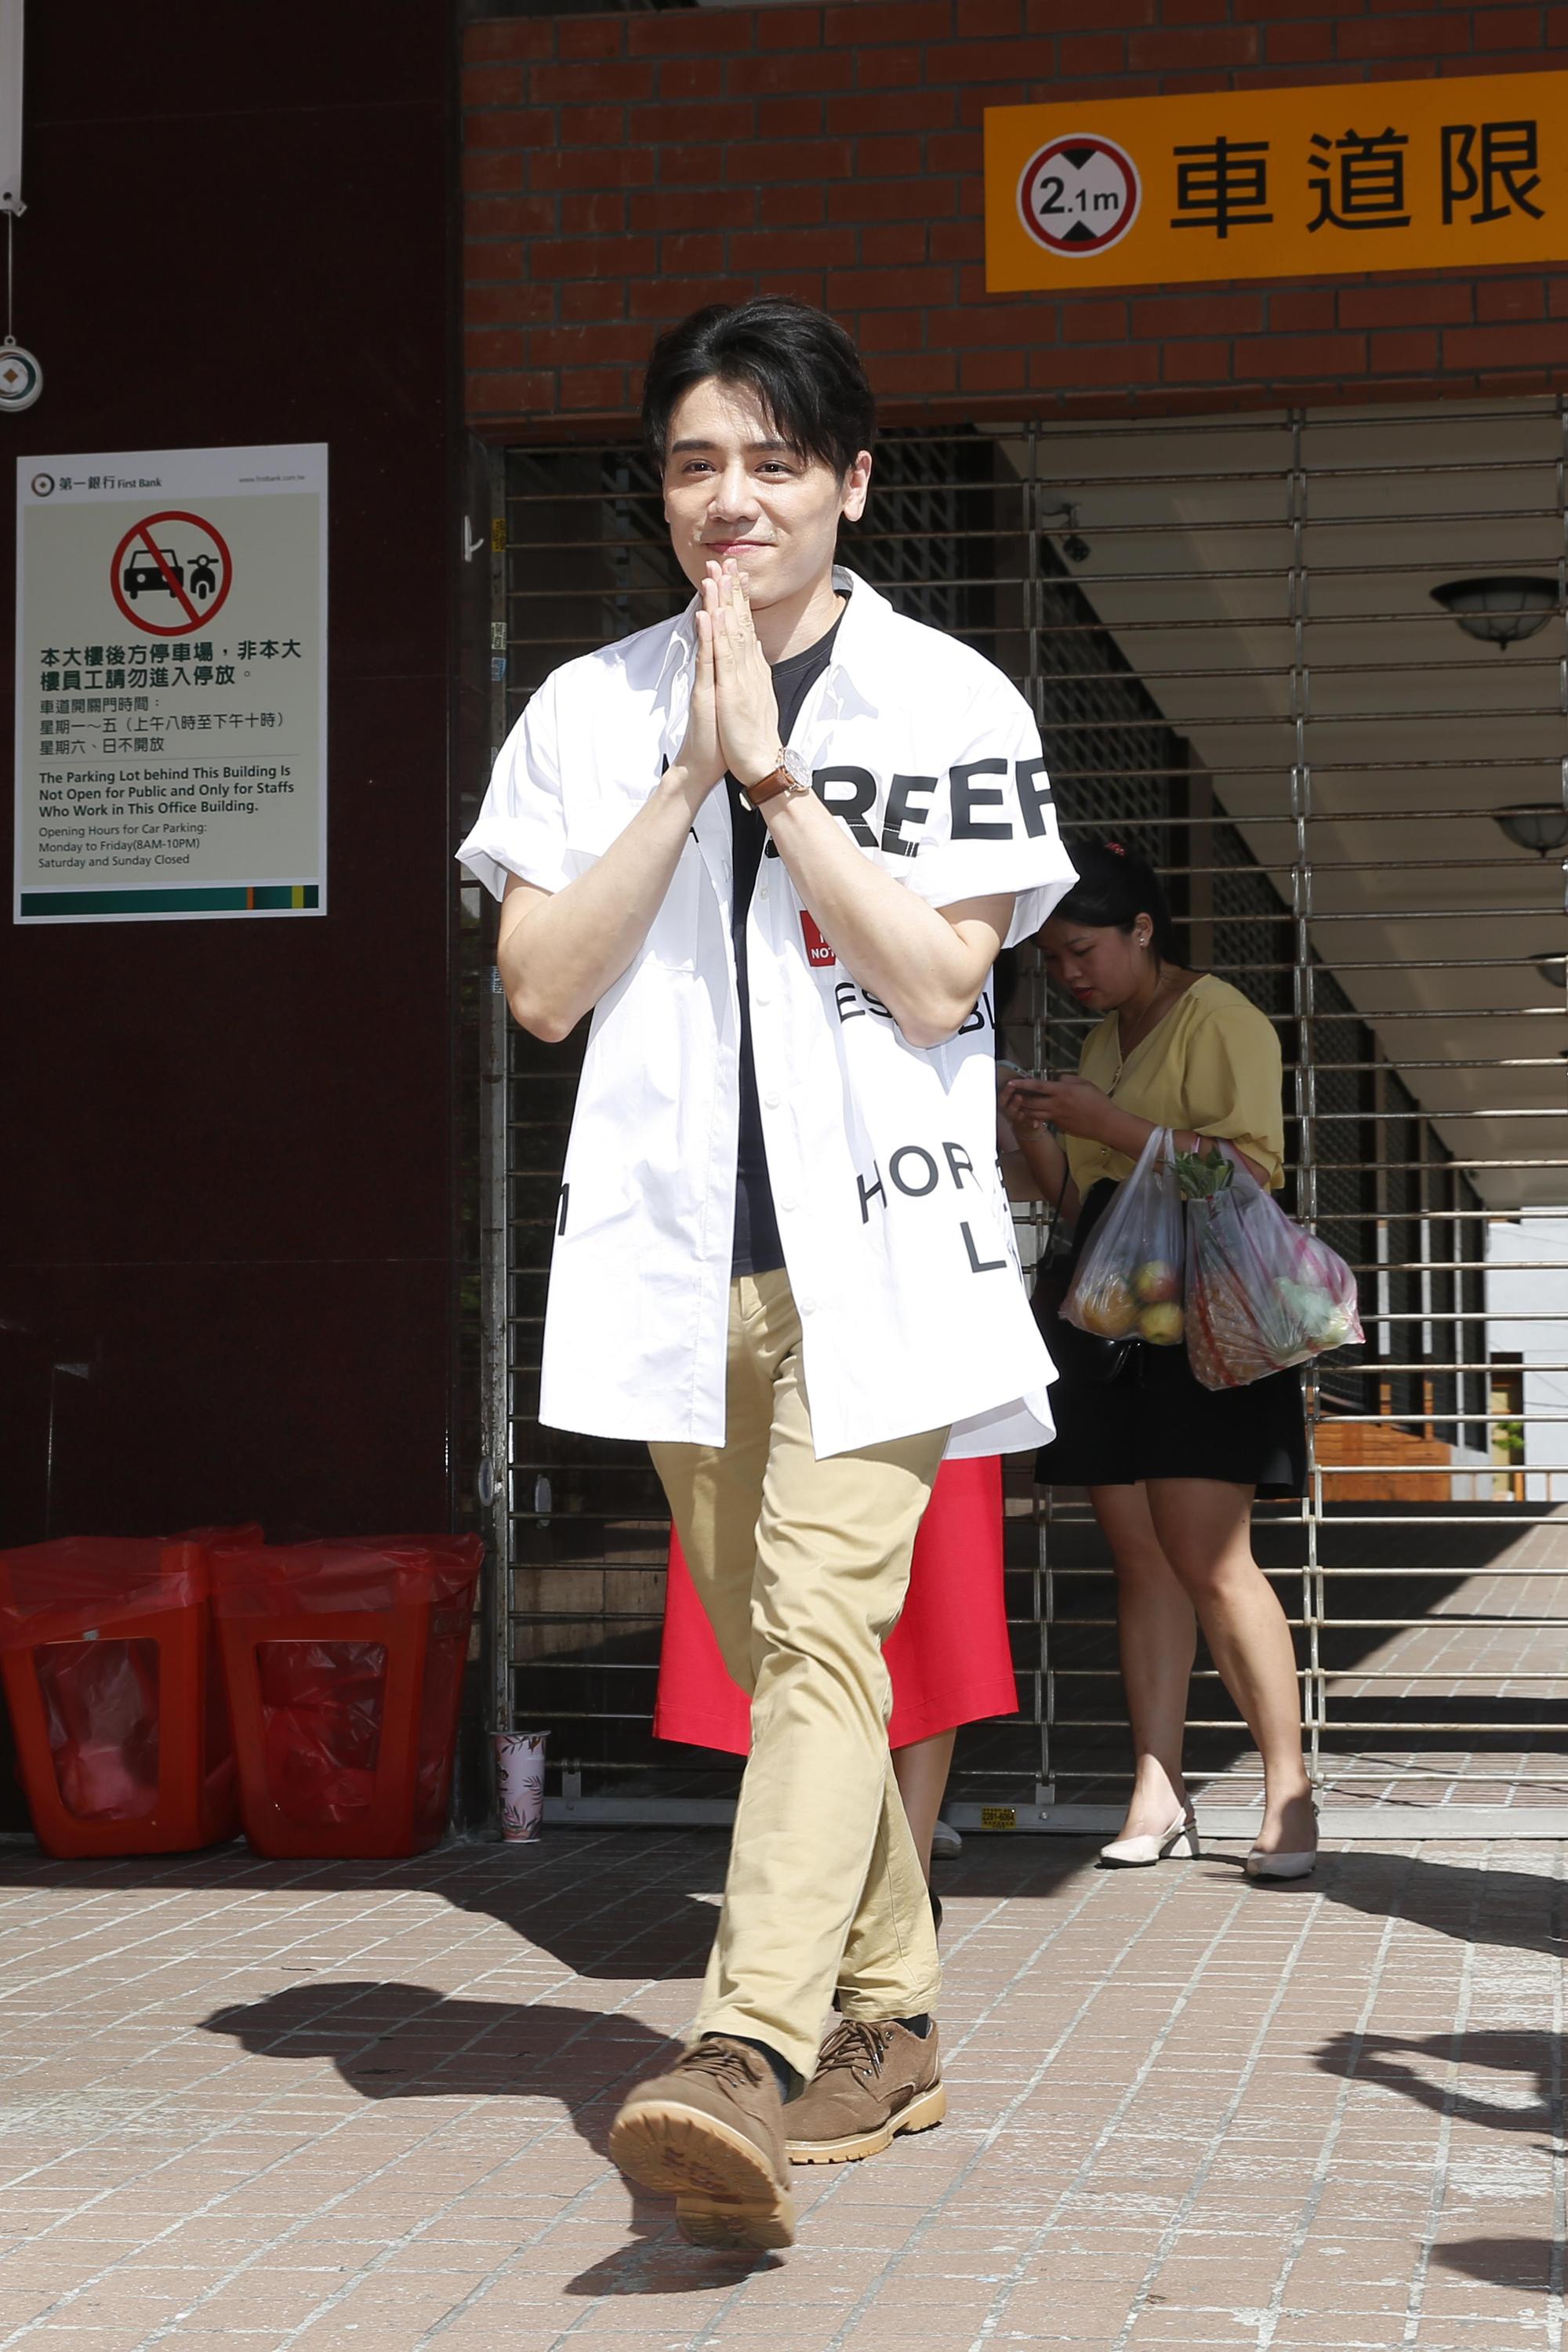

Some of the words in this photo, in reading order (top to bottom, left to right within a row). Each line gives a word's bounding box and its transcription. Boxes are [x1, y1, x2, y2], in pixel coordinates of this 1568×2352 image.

[1169, 119, 1546, 239] 車道限
[1040, 176, 1120, 216] 2.1m
[60, 476, 114, 490] 第一銀行
[118, 479, 136, 488] First
[139, 477, 162, 488] Bank
[39, 772, 63, 783] The
[67, 771, 114, 784] Parking
[120, 771, 140, 781] Lot
[144, 768, 188, 780] behind
[193, 767, 219, 779] This
[223, 765, 276, 779] Building
[281, 765, 290, 775] Is
[40, 790, 63, 800] Not
[67, 789, 101, 802] Open
[106, 787, 125, 798] for
[129, 786, 166, 797] Public
[171, 784, 194, 797] and
[199, 783, 230, 797] Only
[234, 782, 253, 794] for
[257, 781, 294, 793] Staffs
[39, 806, 69, 817] Who
[74, 804, 107, 816] Work
[112, 804, 123, 815] in
[128, 803, 154, 814] This
[158, 801, 197, 813] Office
[201, 800, 258, 814] Building.
[39, 827, 85, 839] Opening
[89, 826, 119, 835] Hours
[123, 824, 139, 834] for
[142, 824, 160, 833] Car
[163, 822, 207, 834] Parking:
[39, 842, 82, 854] Monday
[38, 858, 85, 869] Saturday
[89, 856, 109, 866] and
[112, 855, 151, 867] Sunday
[154, 854, 190, 864] Closed
